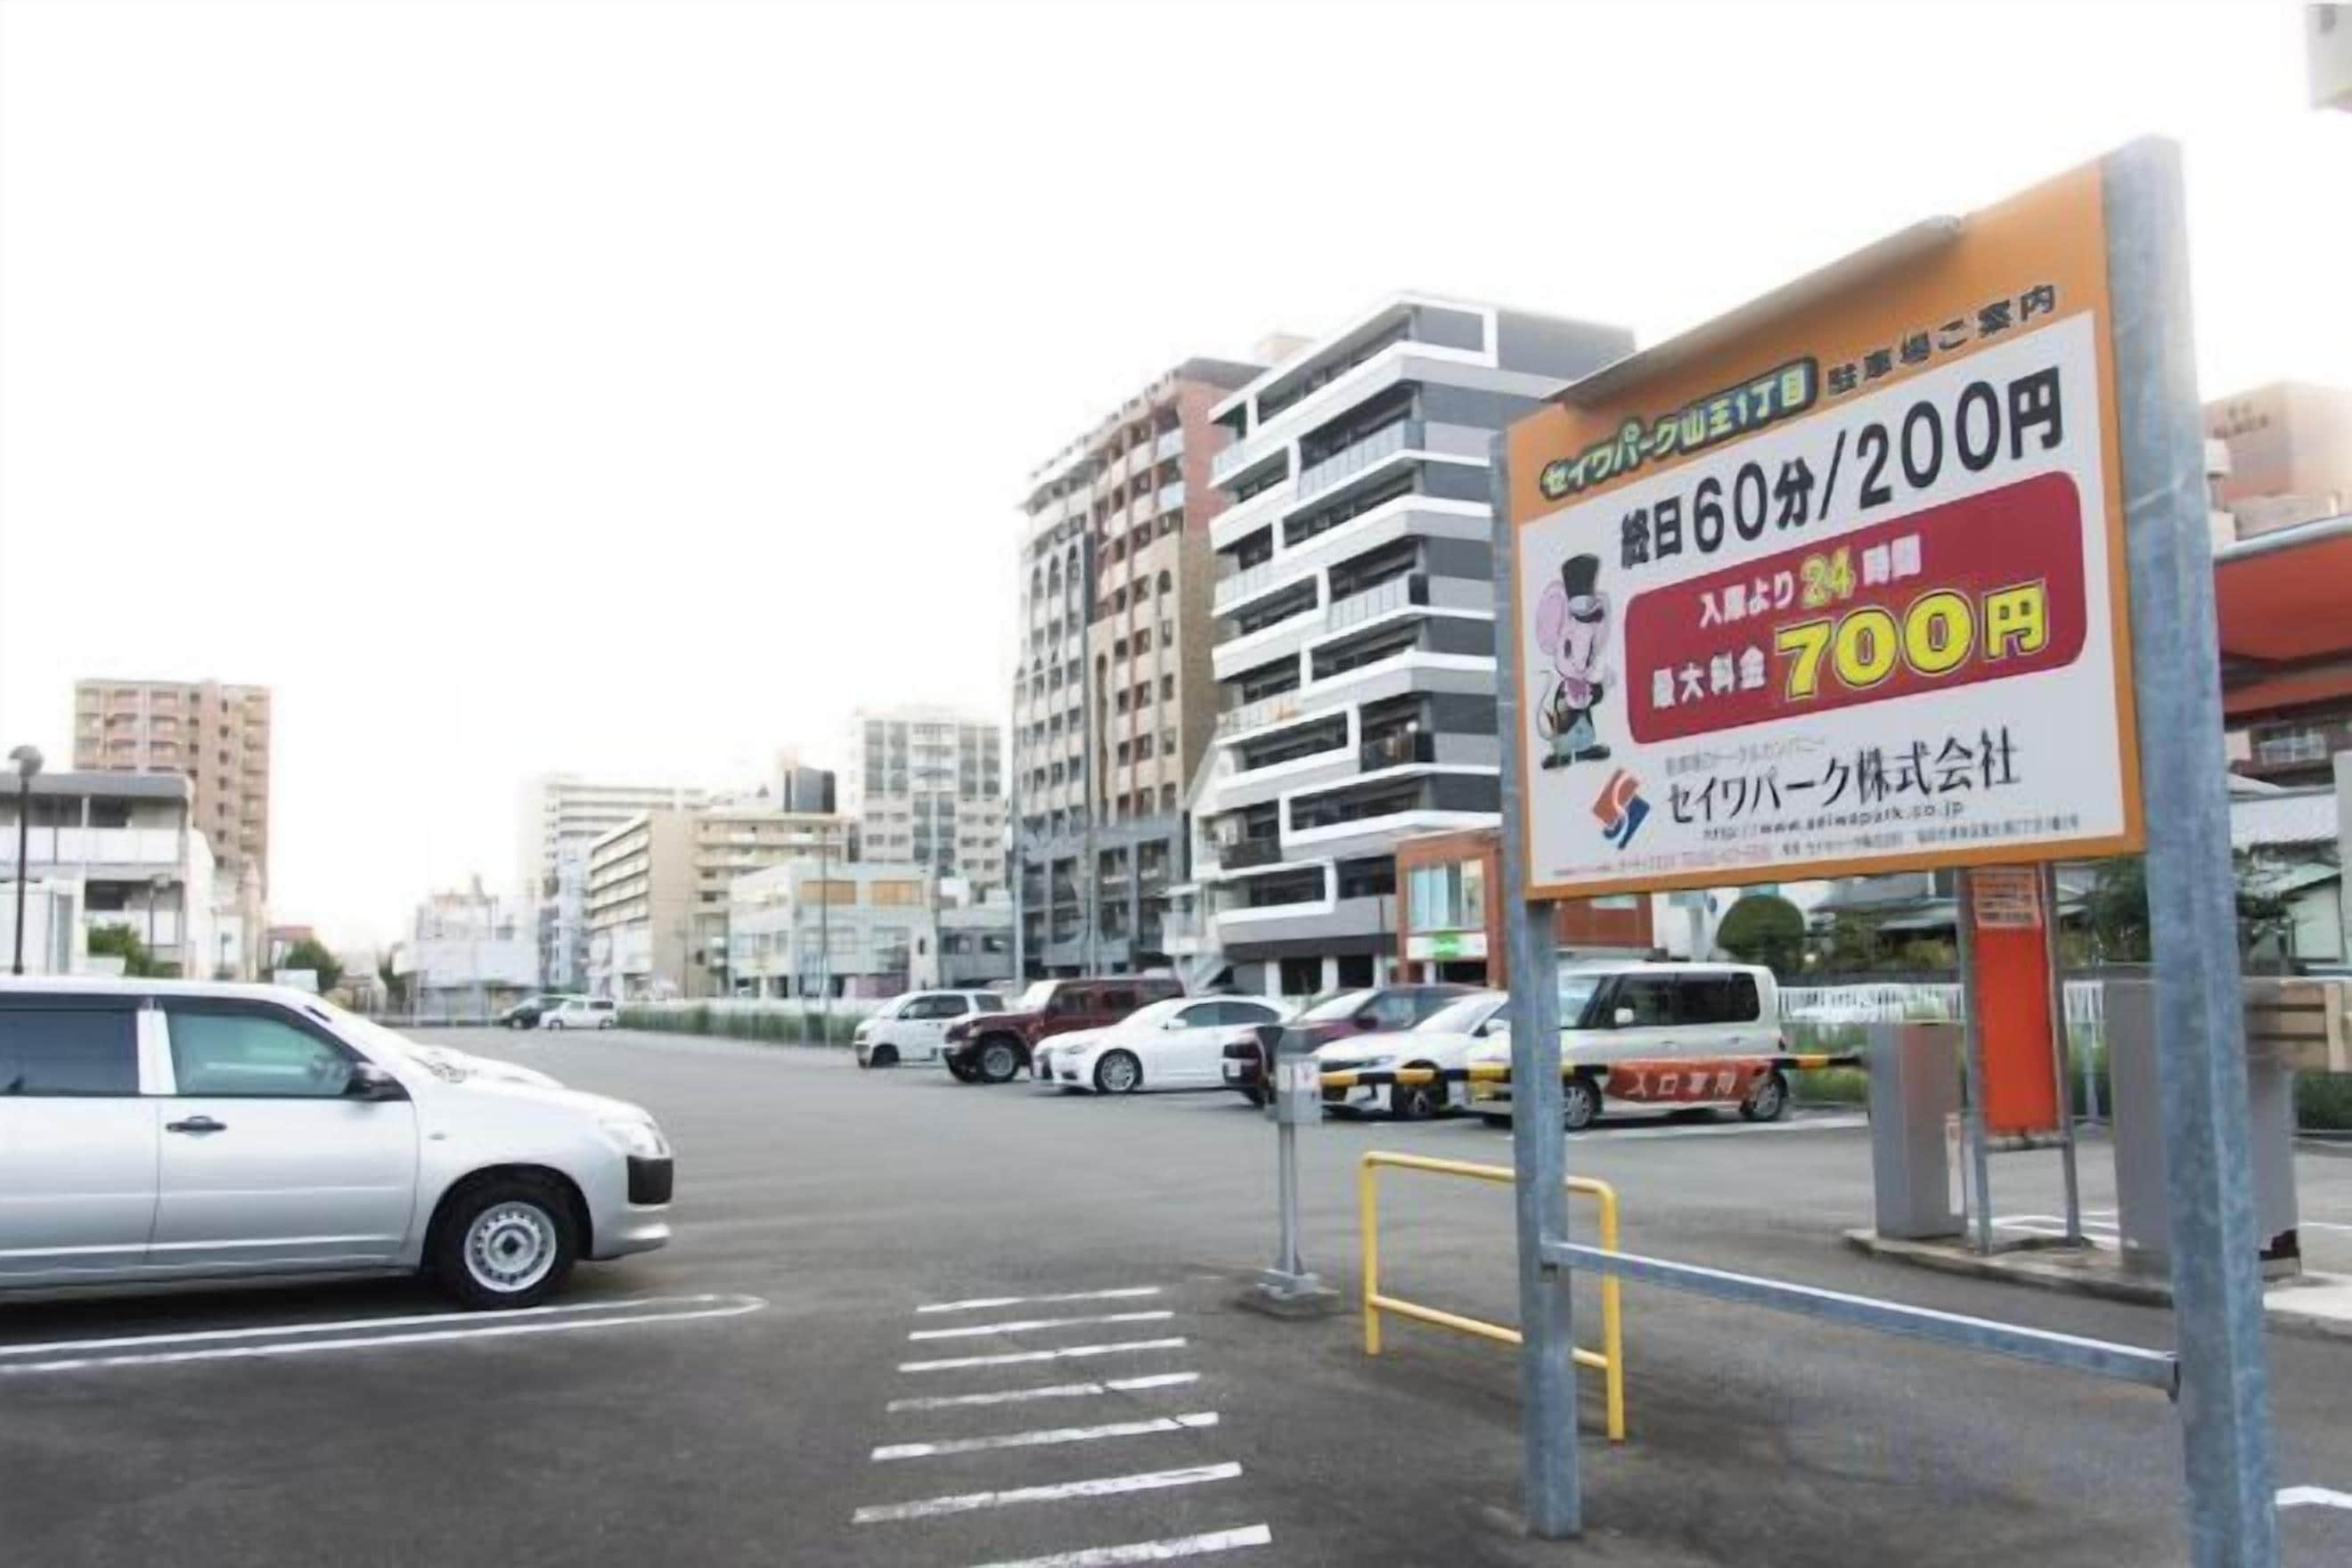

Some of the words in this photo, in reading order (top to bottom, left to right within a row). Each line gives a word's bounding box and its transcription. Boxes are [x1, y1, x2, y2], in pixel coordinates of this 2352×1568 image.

[1774, 577, 2047, 702] 700円
[1668, 725, 2021, 824] セイワパーク株式会社
